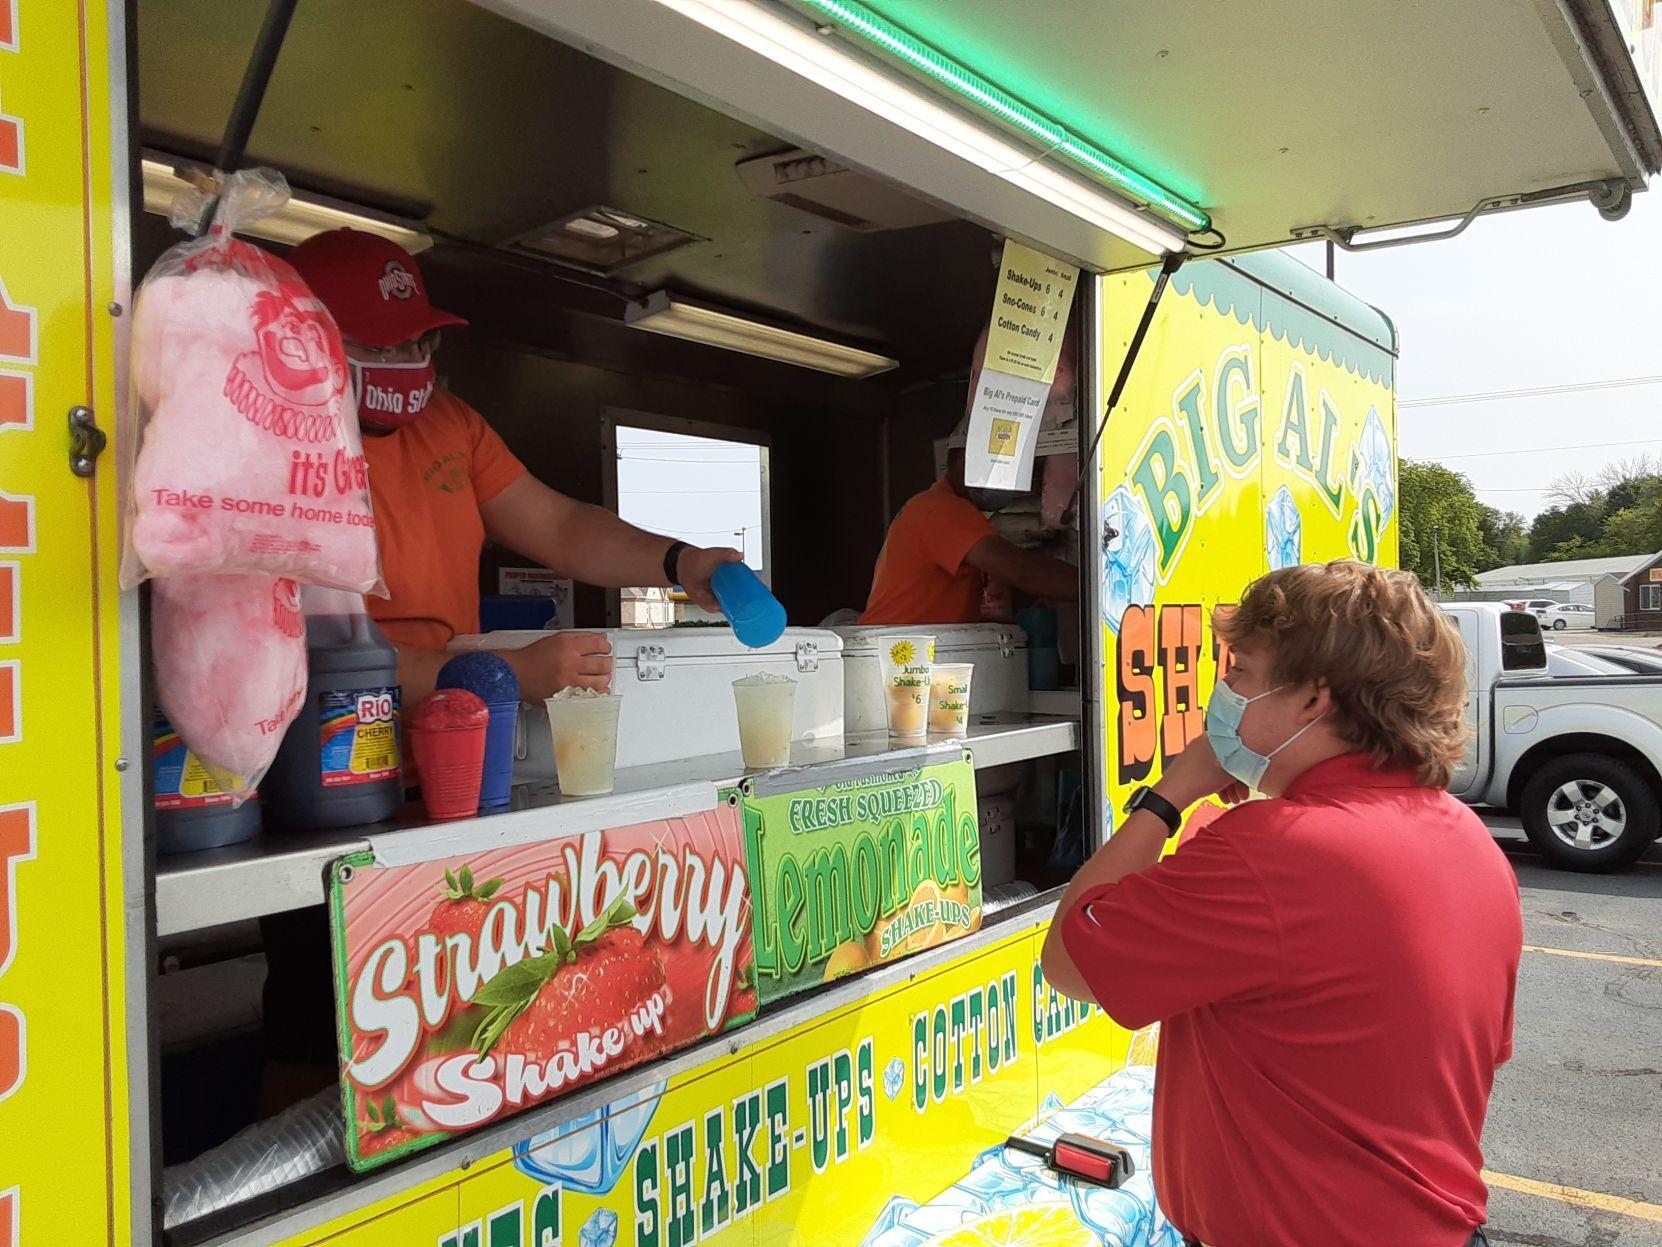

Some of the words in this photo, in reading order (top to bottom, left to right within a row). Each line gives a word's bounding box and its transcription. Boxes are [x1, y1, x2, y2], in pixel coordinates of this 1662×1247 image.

[1002, 293, 1037, 314] Sno-Cones
[1040, 307, 1046, 317] 6
[1053, 311, 1059, 321] 4
[1007, 269, 1042, 292] Shake-Ups
[1045, 284, 1051, 295] 6
[1058, 289, 1064, 299] 4
[998, 317, 1020, 333] Cotton
[1021, 324, 1041, 341] Candy
[1048, 333, 1054, 343] 4
[365, 384, 404, 414] Ohio
[983, 386, 995, 399] Big
[1005, 392, 1028, 405] Prepaid
[1026, 397, 1041, 407] Card
[289, 449, 329, 498] it's
[1127, 345, 1262, 585] BIG
[152, 488, 214, 509] Take
[220, 496, 286, 517] some
[291, 502, 344, 524] home
[346, 509, 375, 529] toda
[902, 665, 930, 675] Jumbo
[788, 797, 853, 834] FRESH
[855, 777, 944, 824] SQUEEZED
[742, 788, 981, 978] Lemonade
[880, 897, 971, 958] SHAKE-UPS
[346, 830, 748, 1086] Strawberry
[420, 1026, 626, 1128] Shake
[630, 990, 666, 1041] up
[634, 1035, 876, 1247] SHAKE-UPS
[912, 969, 1018, 1115] COTTON
